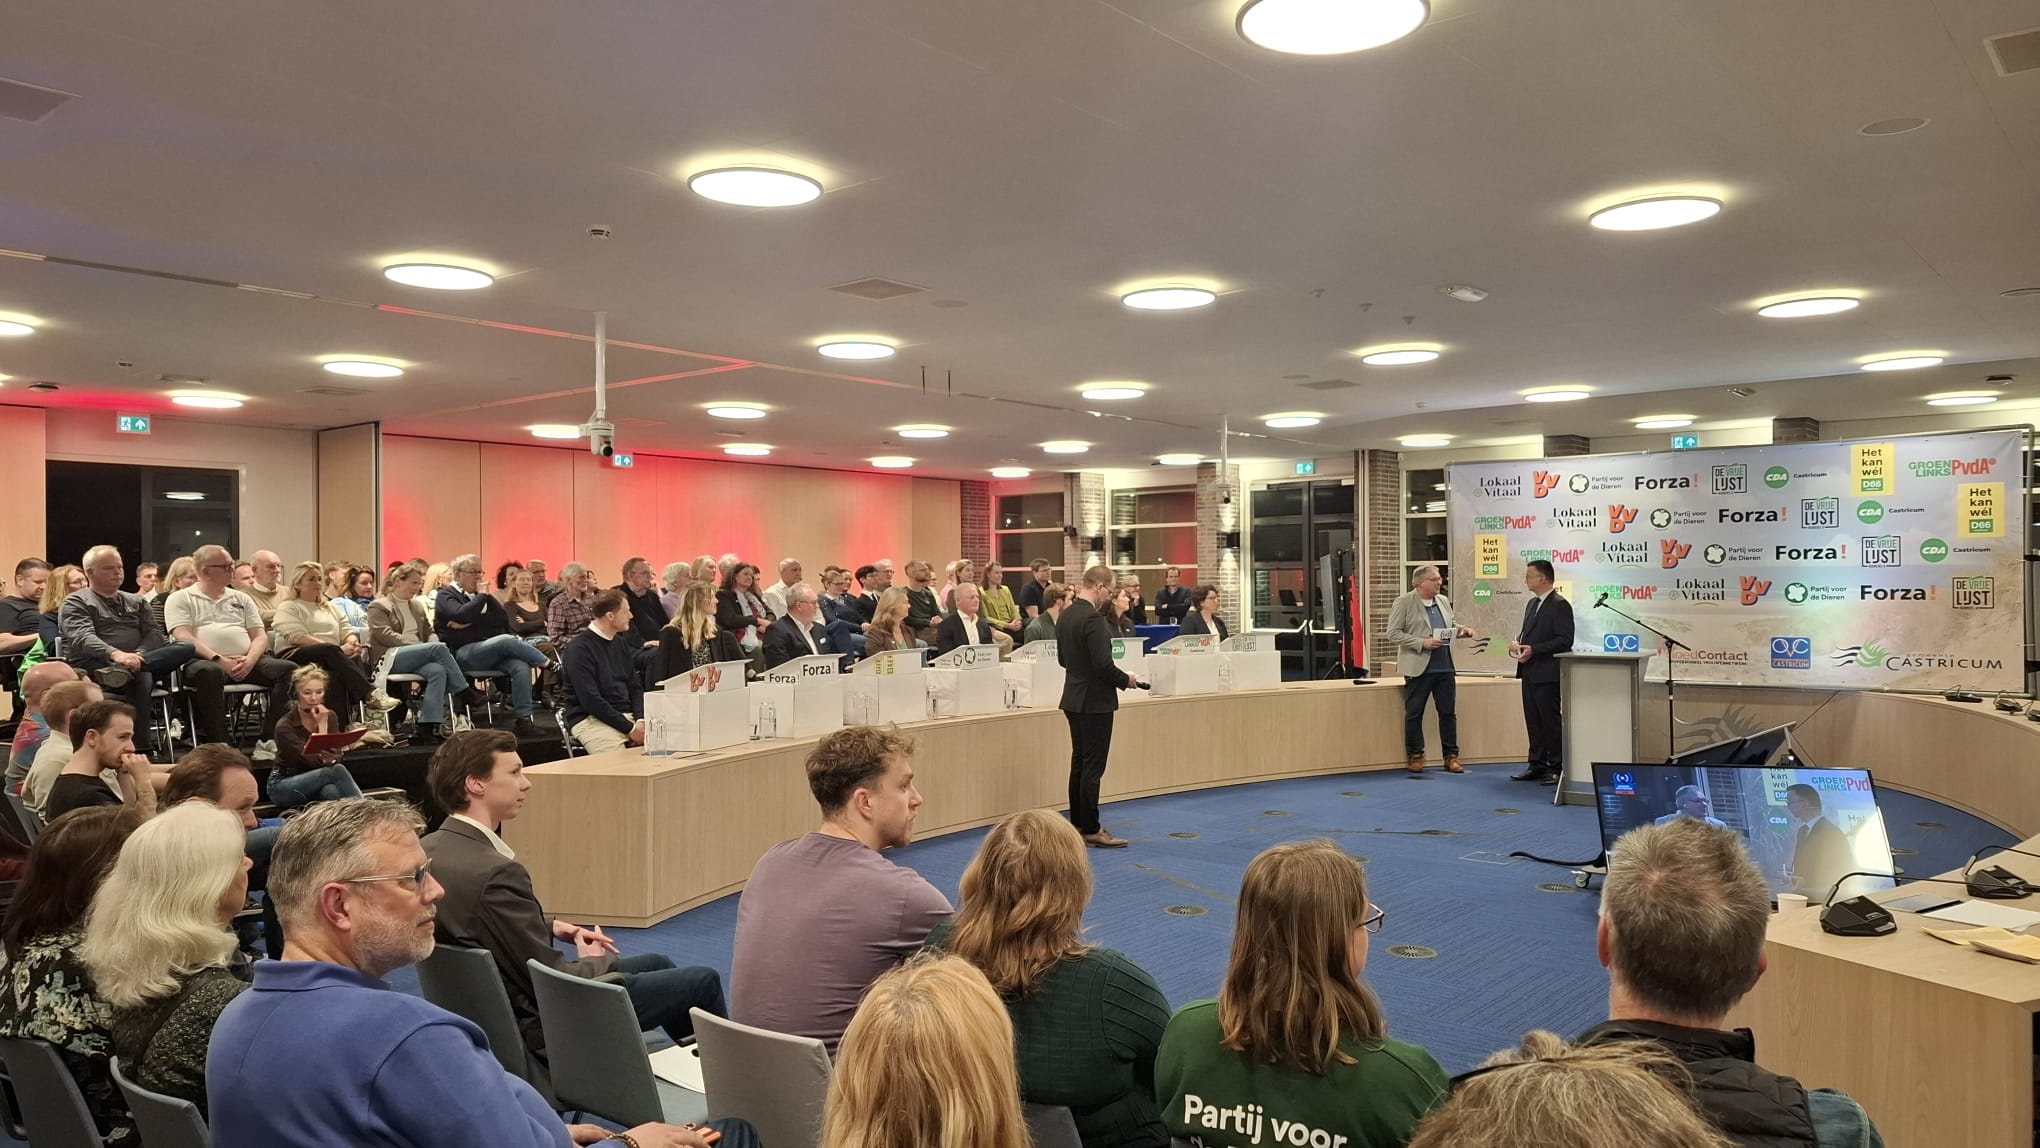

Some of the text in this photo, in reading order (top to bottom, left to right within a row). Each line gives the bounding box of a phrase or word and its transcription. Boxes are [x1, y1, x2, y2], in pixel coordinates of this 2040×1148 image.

[1862, 448, 1882, 456] Het
[1862, 458, 1882, 466] kan
[1908, 460, 1952, 470] GROEN
[1952, 458, 1990, 476] PvdA
[1714, 468, 1724, 476] DE
[1862, 466, 1882, 476] wél
[1916, 468, 1952, 478] LINKS
[1480, 476, 1520, 487] Lokaal
[1533, 470, 1560, 498] VVD
[1863, 480, 1882, 488] D66
[1484, 487, 1520, 496] Vitaal
[1970, 488, 1992, 496] Het
[1805, 502, 1814, 510] DE
[1970, 498, 1992, 506] kan
[1553, 506, 1596, 518] Lokaal
[1858, 508, 1882, 516] CDA
[1970, 506, 1992, 516] wél
[1504, 516, 1532, 529] PvdA
[1558, 518, 1596, 528] Vitaal
[1608, 504, 1638, 533] VVD
[1971, 521, 1992, 530] D66
[1602, 542, 1648, 552] Lokaal
[1866, 540, 1874, 548] DE
[1660, 539, 1692, 568] VVD
[1922, 546, 1946, 554] CDA
[1552, 549, 1580, 562] PvdA
[1608, 552, 1648, 562] Vitaal
[1676, 578, 1724, 589] Lokaal
[1956, 580, 1967, 590] DE
[1622, 586, 1652, 600] PvdA
[1682, 590, 1724, 600] Vitaal
[1740, 576, 1772, 606] VVD
[1772, 660, 1810, 668] CASTRICUM
[1184, 1094, 1348, 1148] Partij voor
